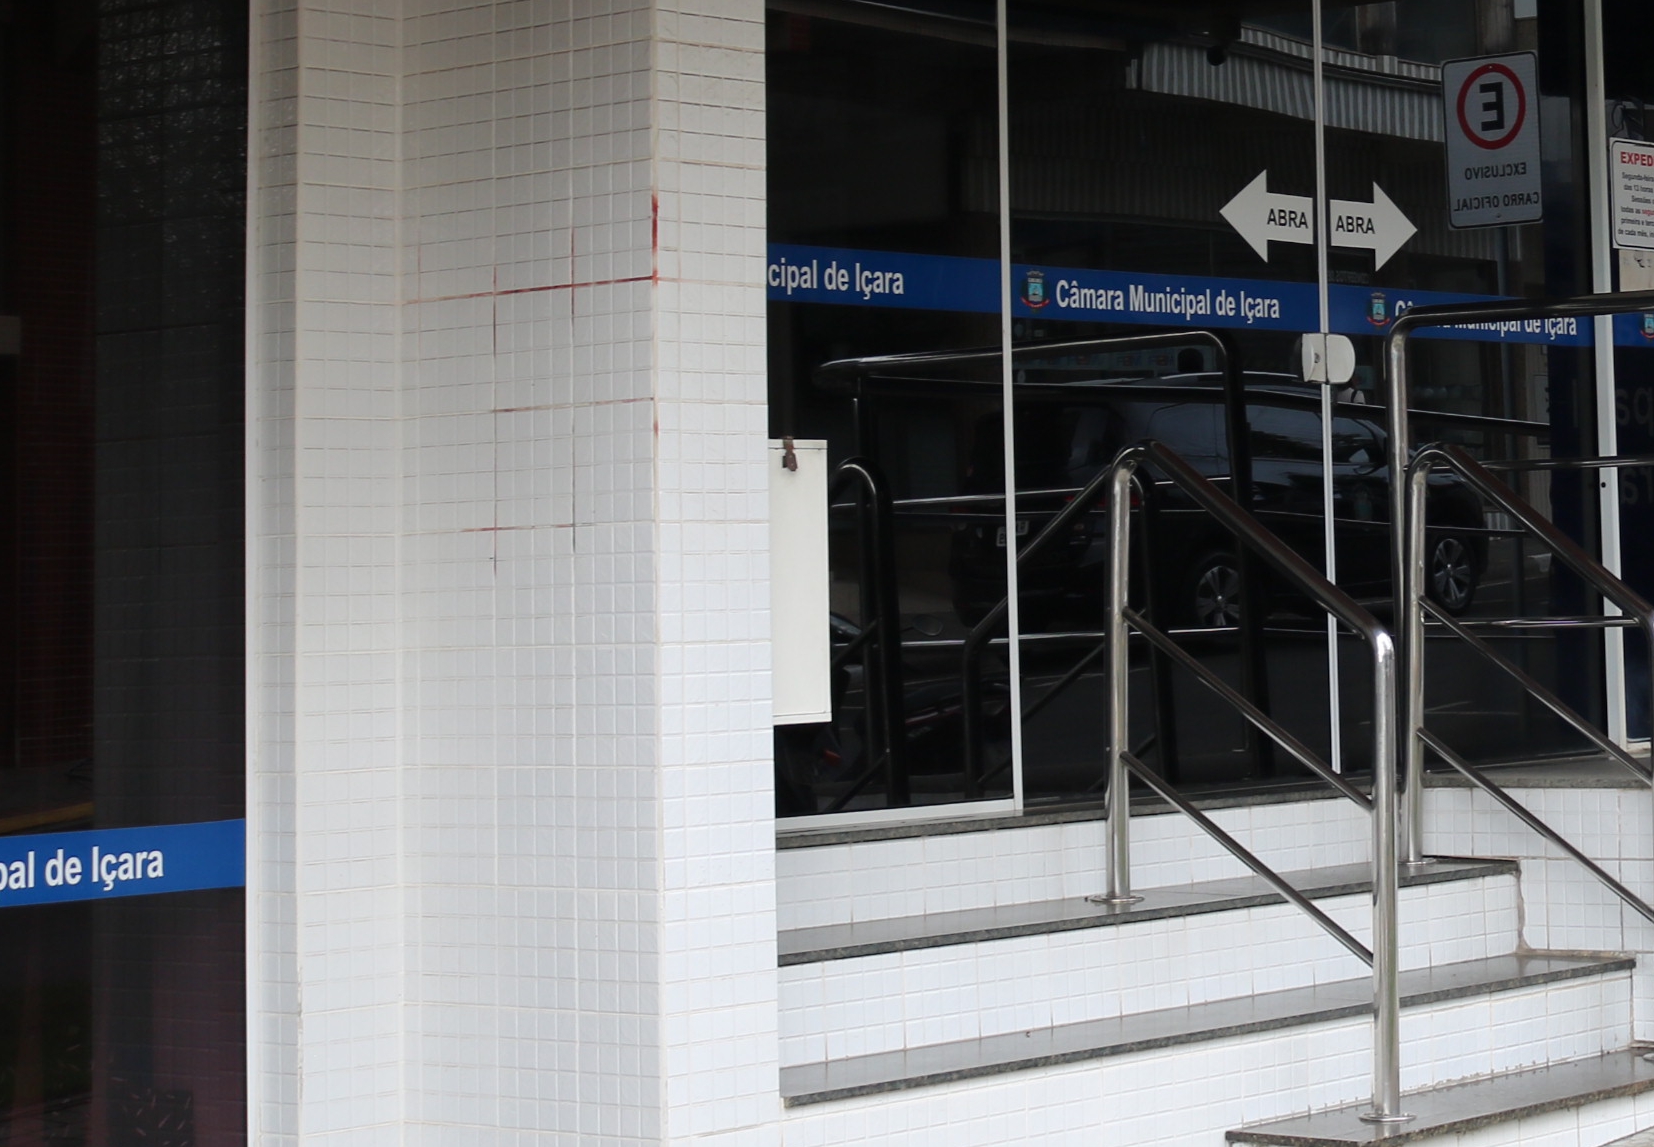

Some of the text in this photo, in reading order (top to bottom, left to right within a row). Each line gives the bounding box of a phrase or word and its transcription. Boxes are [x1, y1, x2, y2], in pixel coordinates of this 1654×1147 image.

[1267, 208, 1309, 229] ABRA
[1335, 214, 1376, 234] ABRA
[824, 261, 849, 291] de
[855, 262, 905, 300] Içara
[1056, 279, 1280, 324] Câmara Municipal de Içara
[45, 849, 82, 887] de
[92, 846, 164, 892] Içara
